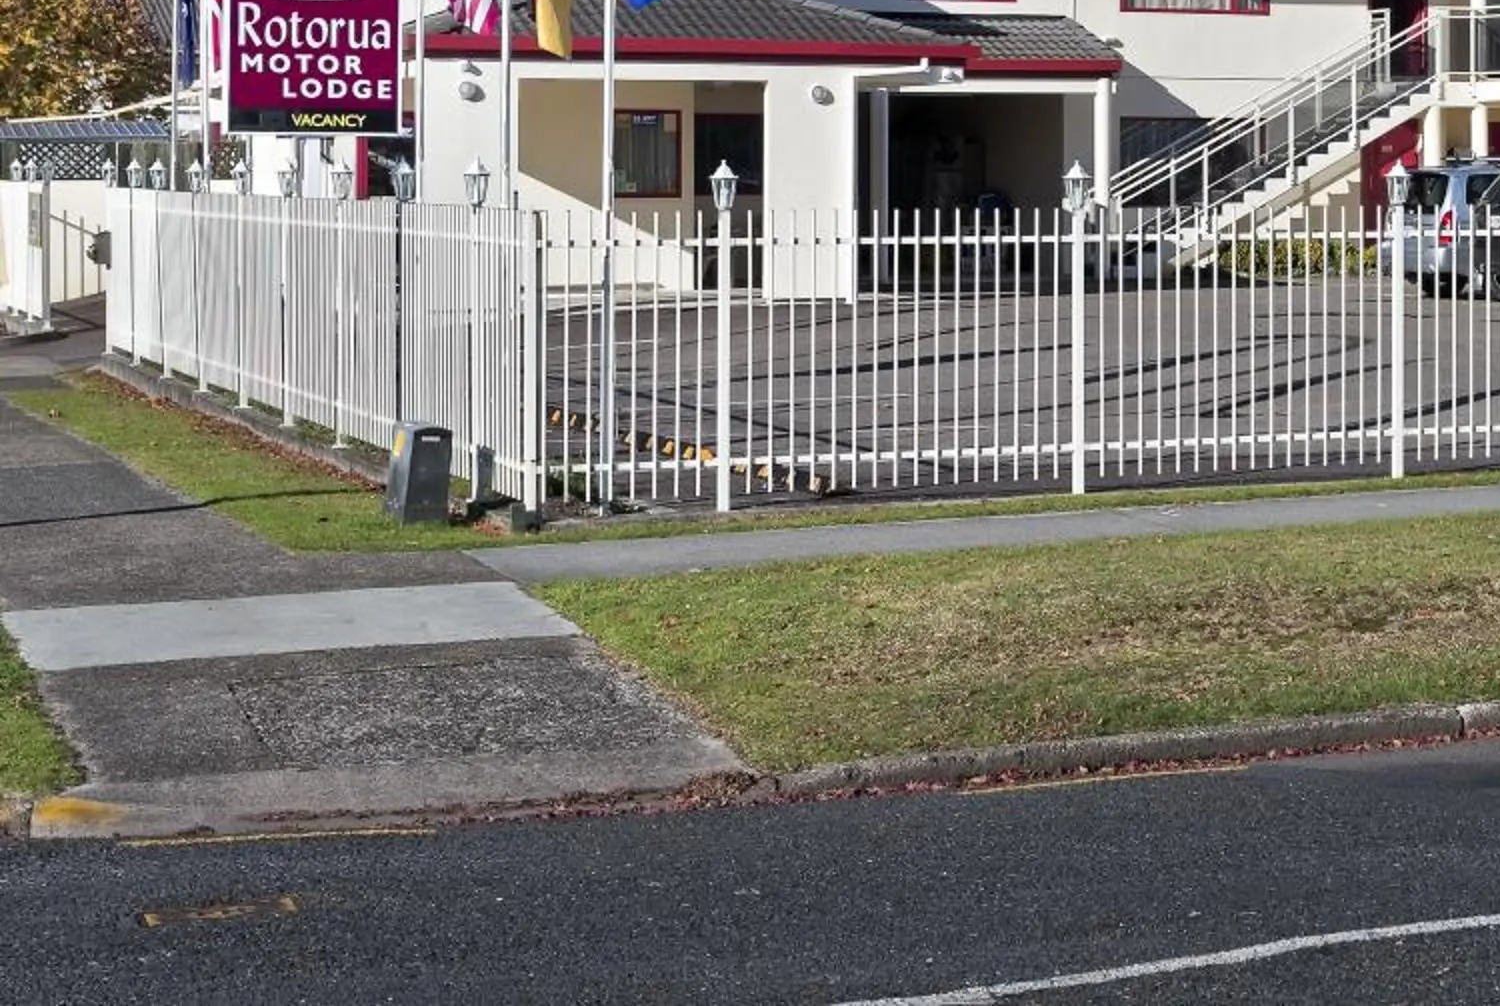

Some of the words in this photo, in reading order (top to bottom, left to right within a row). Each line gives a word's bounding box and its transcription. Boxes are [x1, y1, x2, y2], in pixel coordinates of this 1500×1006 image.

[237, 1, 391, 49] Rotorua
[240, 53, 363, 74] MOTOR
[282, 78, 393, 99] LODGE
[291, 113, 367, 127] VACANCY
